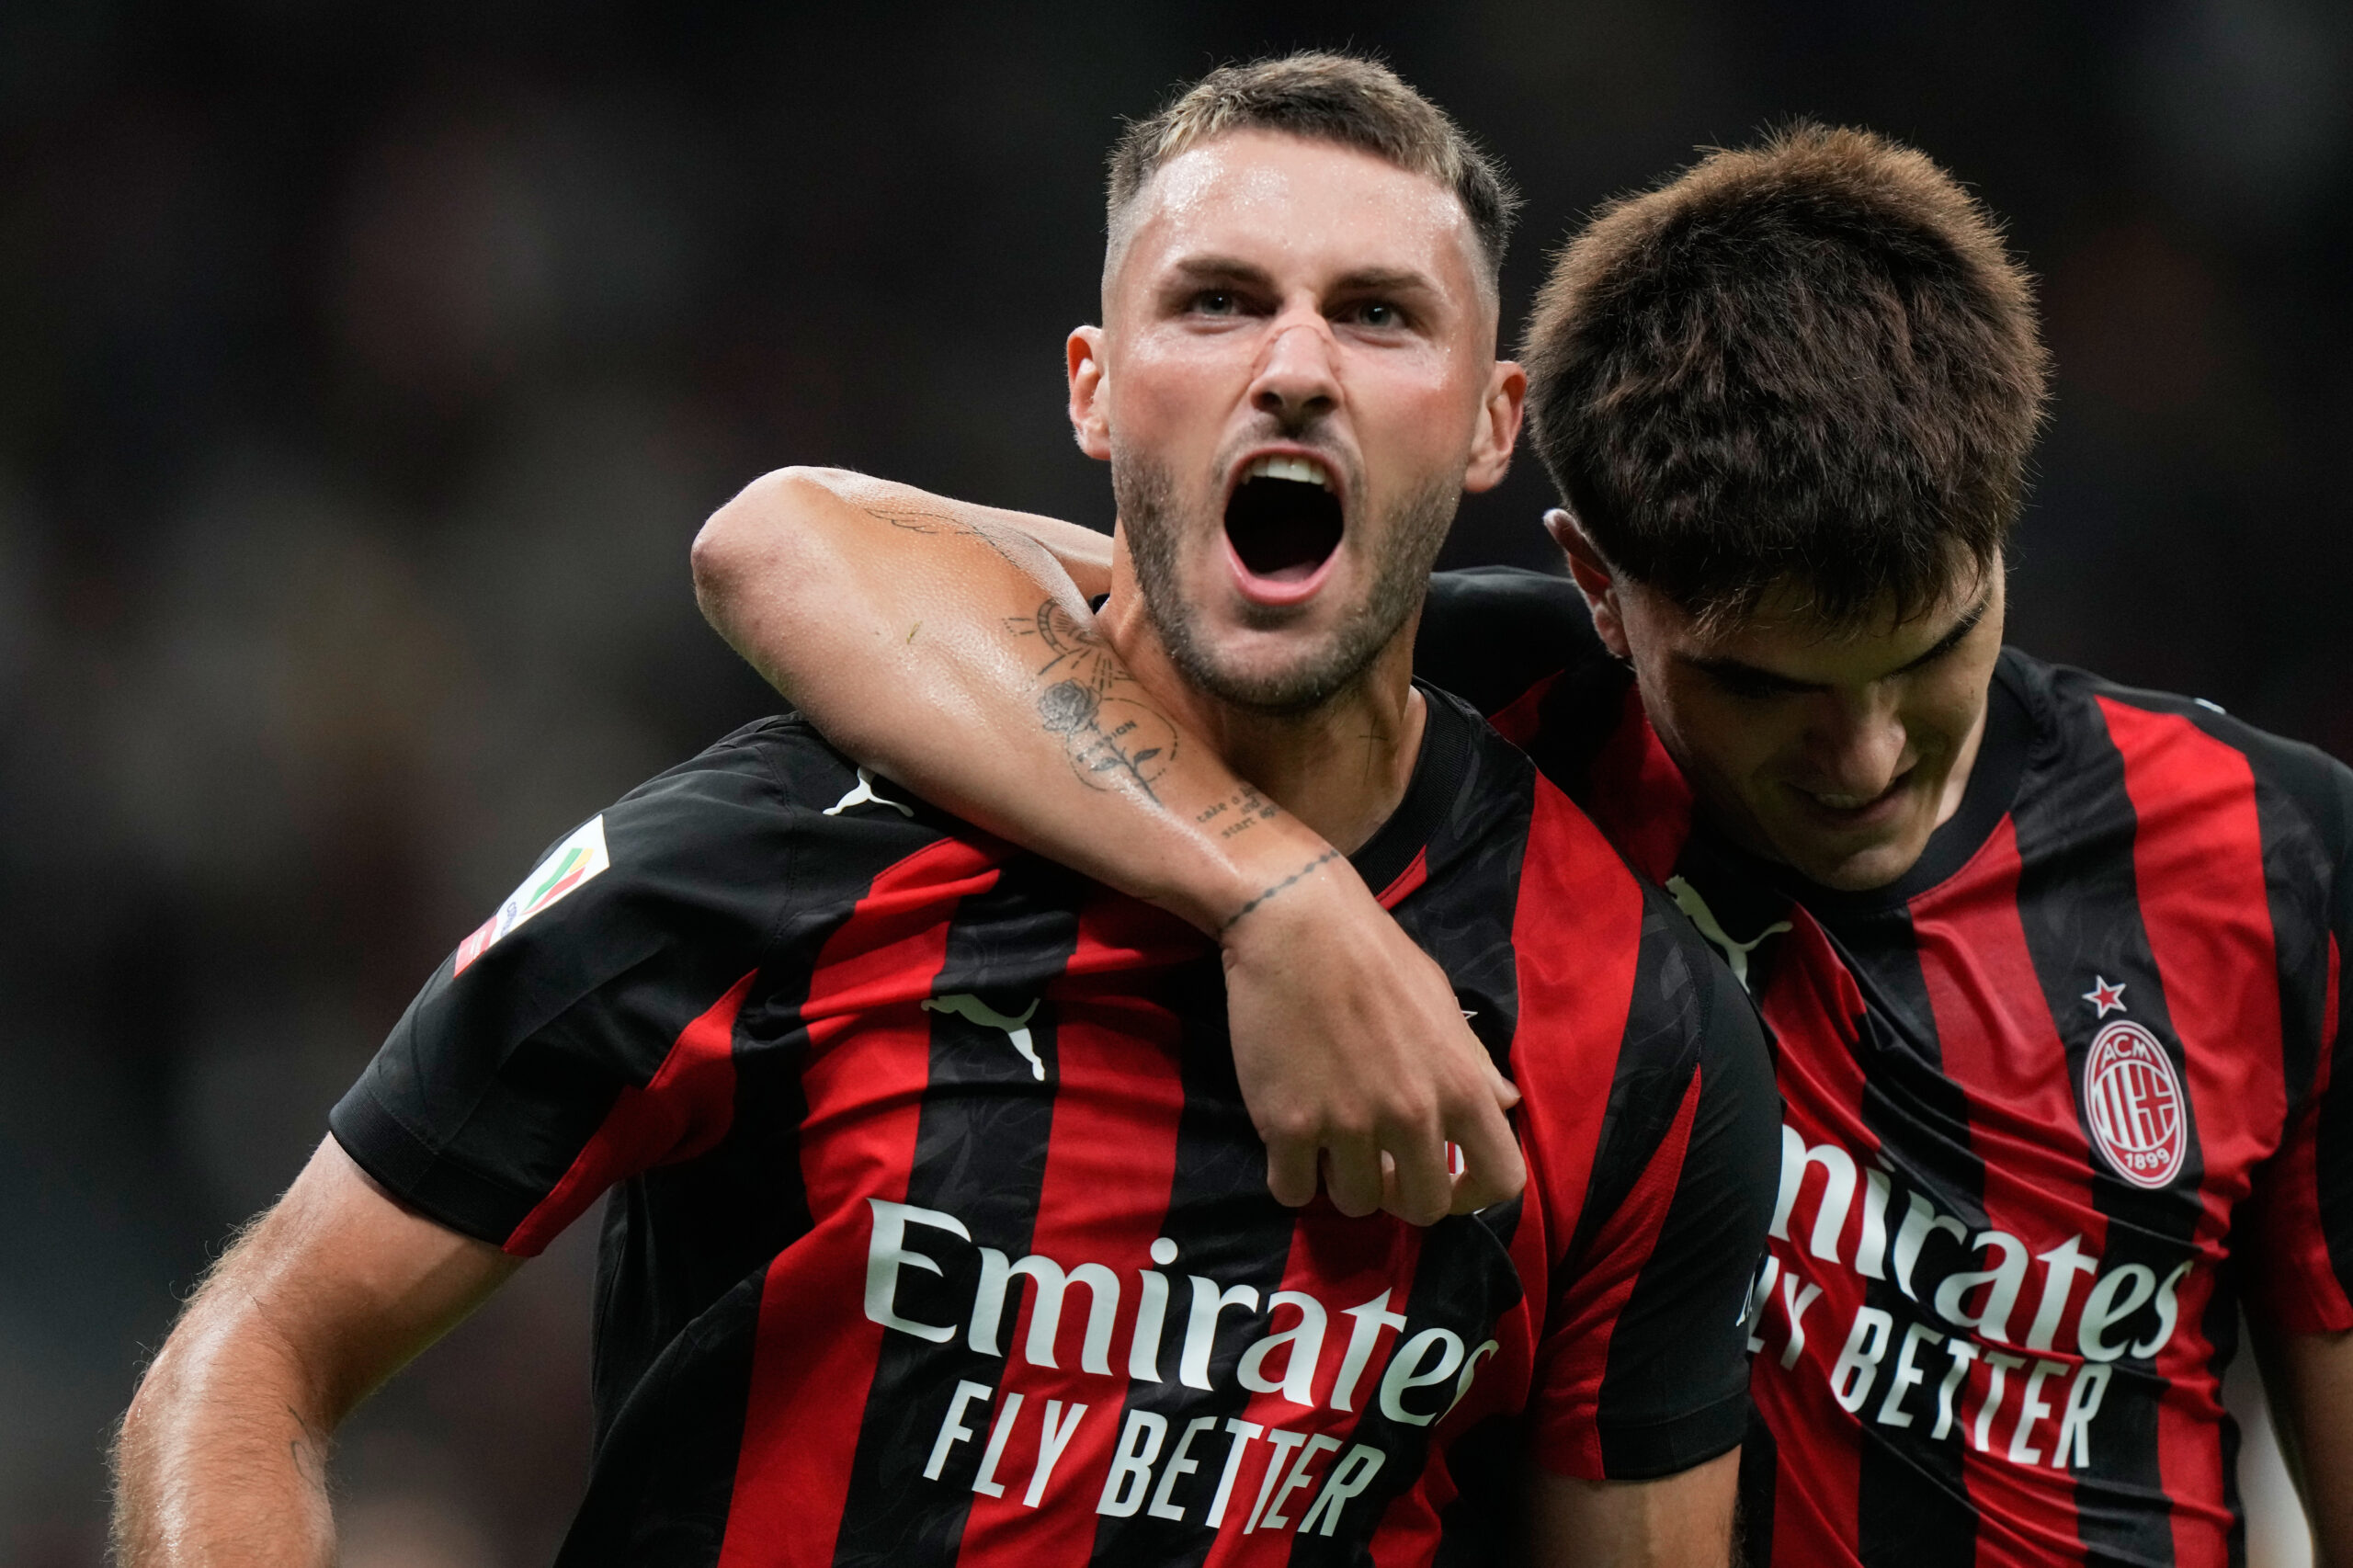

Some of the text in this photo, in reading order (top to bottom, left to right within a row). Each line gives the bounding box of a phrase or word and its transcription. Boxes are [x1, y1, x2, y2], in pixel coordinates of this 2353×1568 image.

[2100, 1035, 2152, 1069] ACM
[1768, 1123, 2194, 1362] mirates
[2125, 1148, 2170, 1170] 1899
[864, 1198, 1499, 1426] Emirates
[1746, 1255, 2112, 1469] LY BETTER
[923, 1380, 1386, 1537] FLY BETTER
